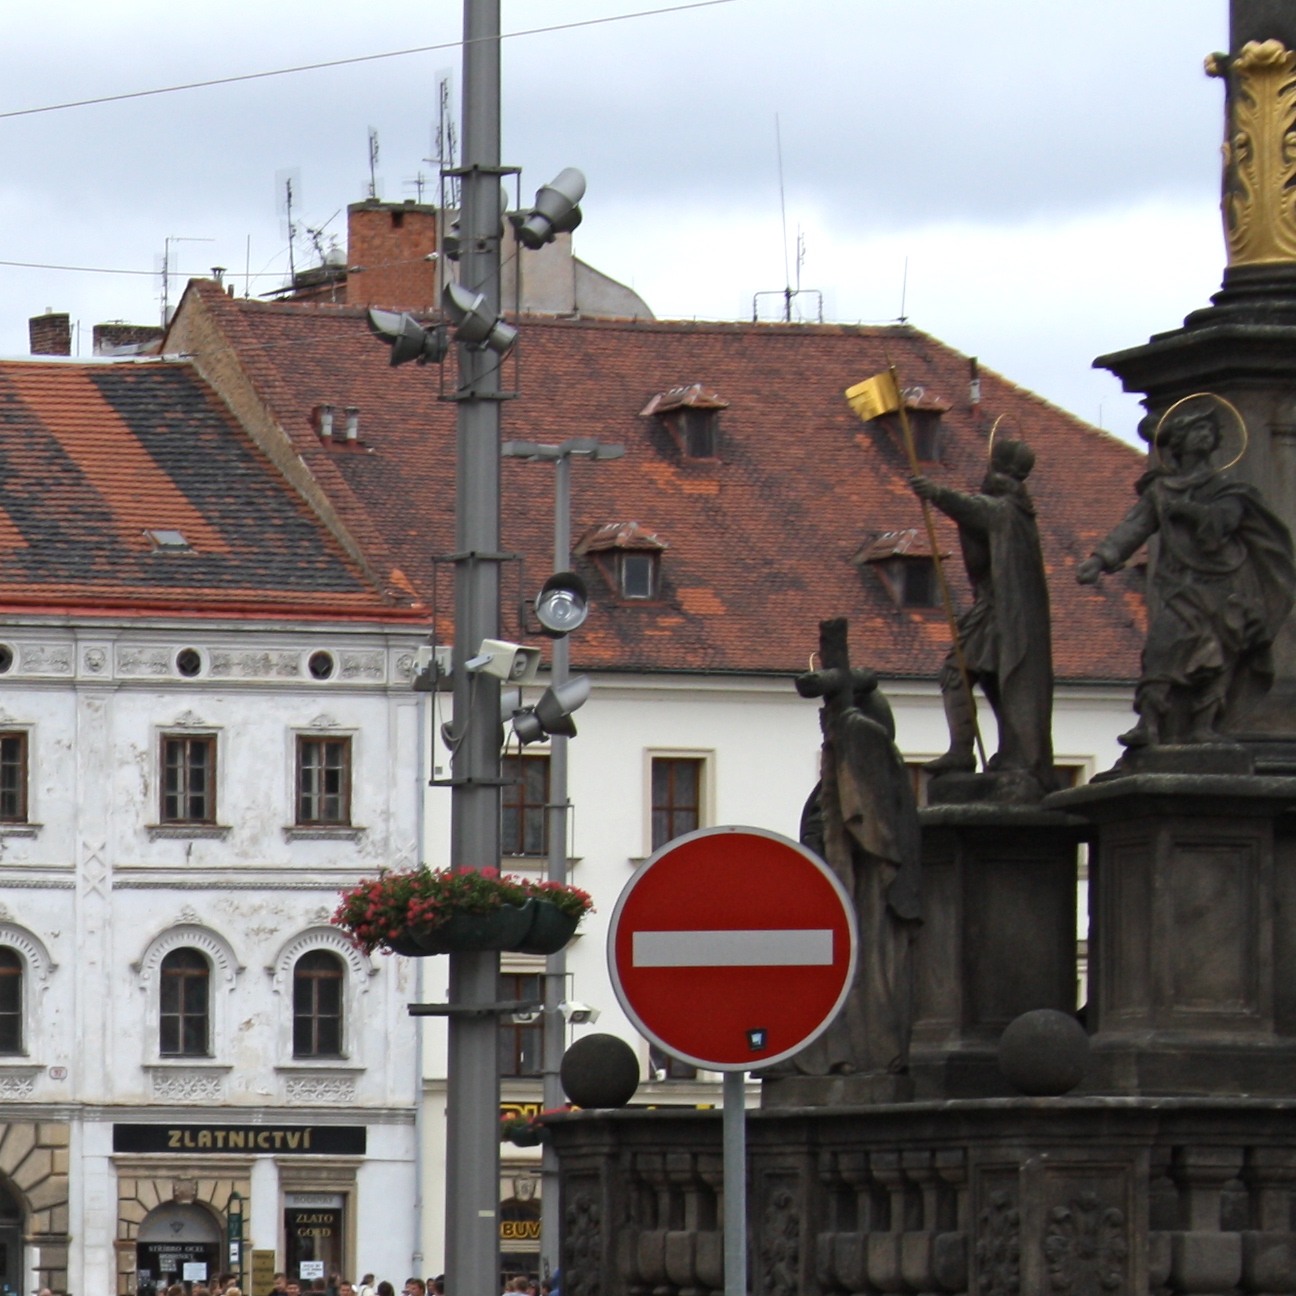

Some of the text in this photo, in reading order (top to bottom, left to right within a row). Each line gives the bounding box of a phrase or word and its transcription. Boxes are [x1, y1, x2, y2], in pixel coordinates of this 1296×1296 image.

[167, 1128, 313, 1149] ZLATNICTVÍ
[295, 1213, 334, 1223] ZLATO
[499, 1220, 541, 1239] BUV
